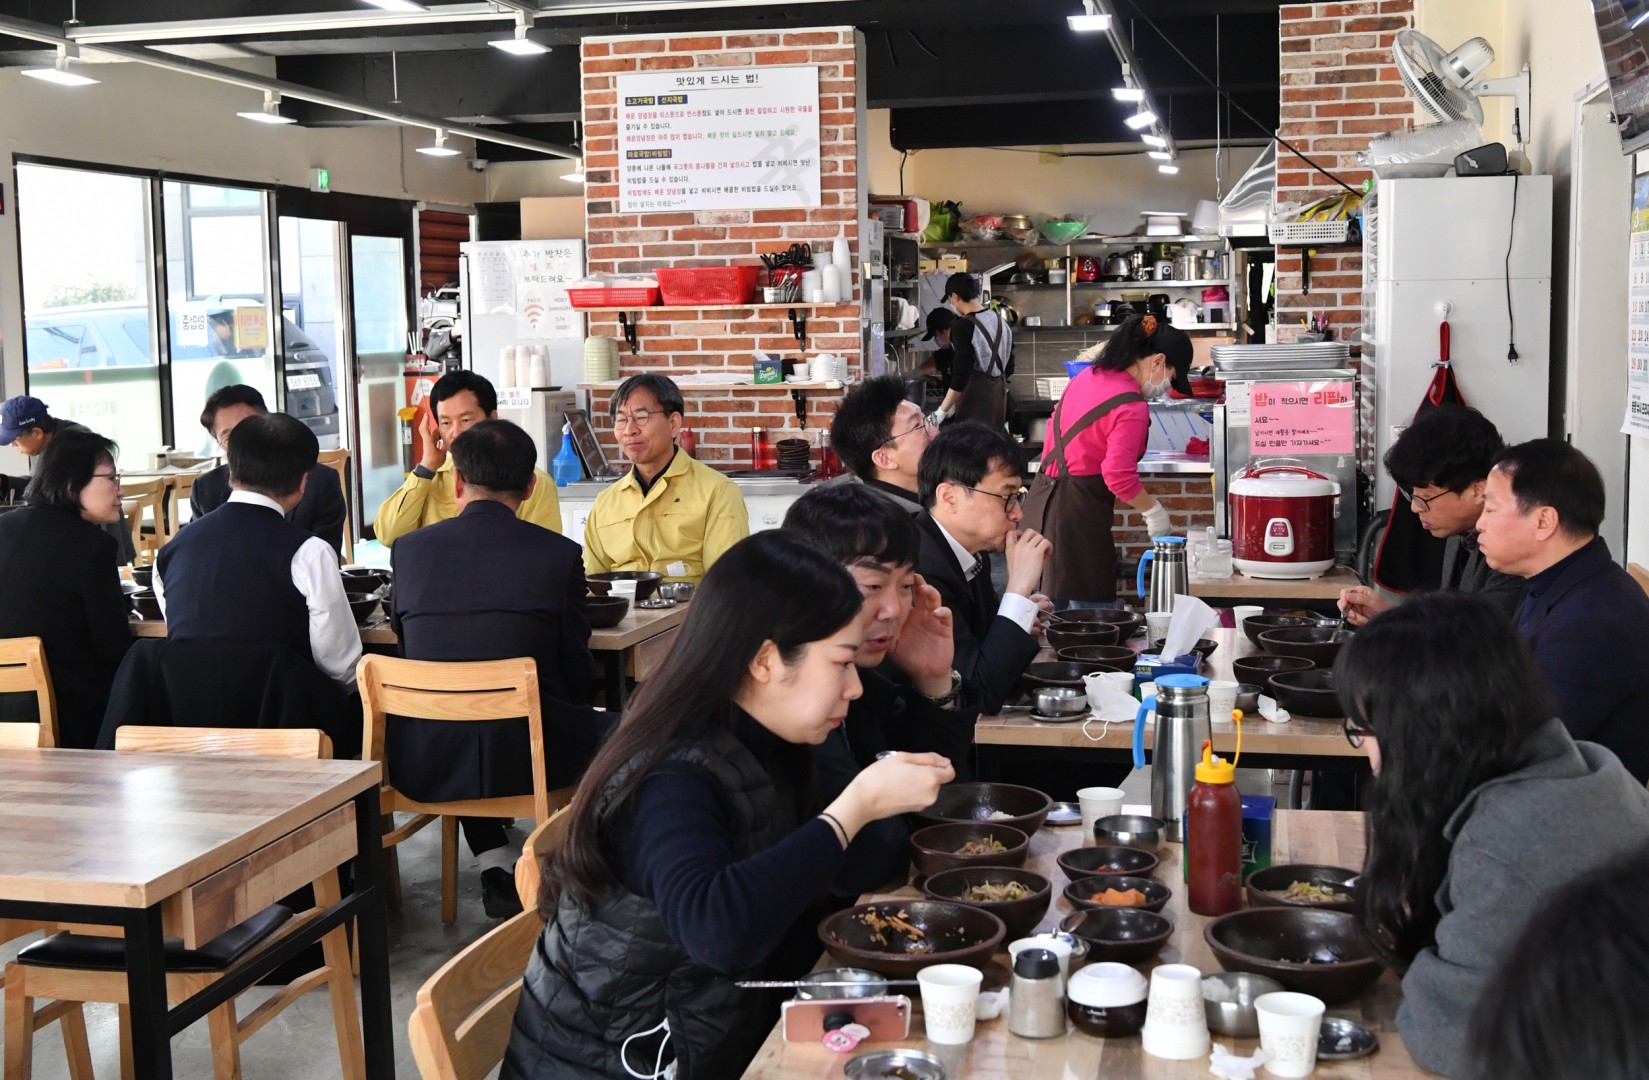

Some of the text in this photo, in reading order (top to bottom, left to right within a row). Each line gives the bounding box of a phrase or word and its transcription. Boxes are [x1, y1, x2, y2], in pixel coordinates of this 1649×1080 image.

[676, 74, 759, 86] 맛있게 드시는 법!
[1634, 207, 1640, 227] 3
[522, 249, 572, 259] 추가 반찬은
[1632, 301, 1637, 312] 15
[1639, 301, 1644, 312] 16
[1631, 330, 1636, 341] 22
[1631, 358, 1648, 371] 29 30 31
[1255, 391, 1348, 407] 밥이 적으시면 리필하
